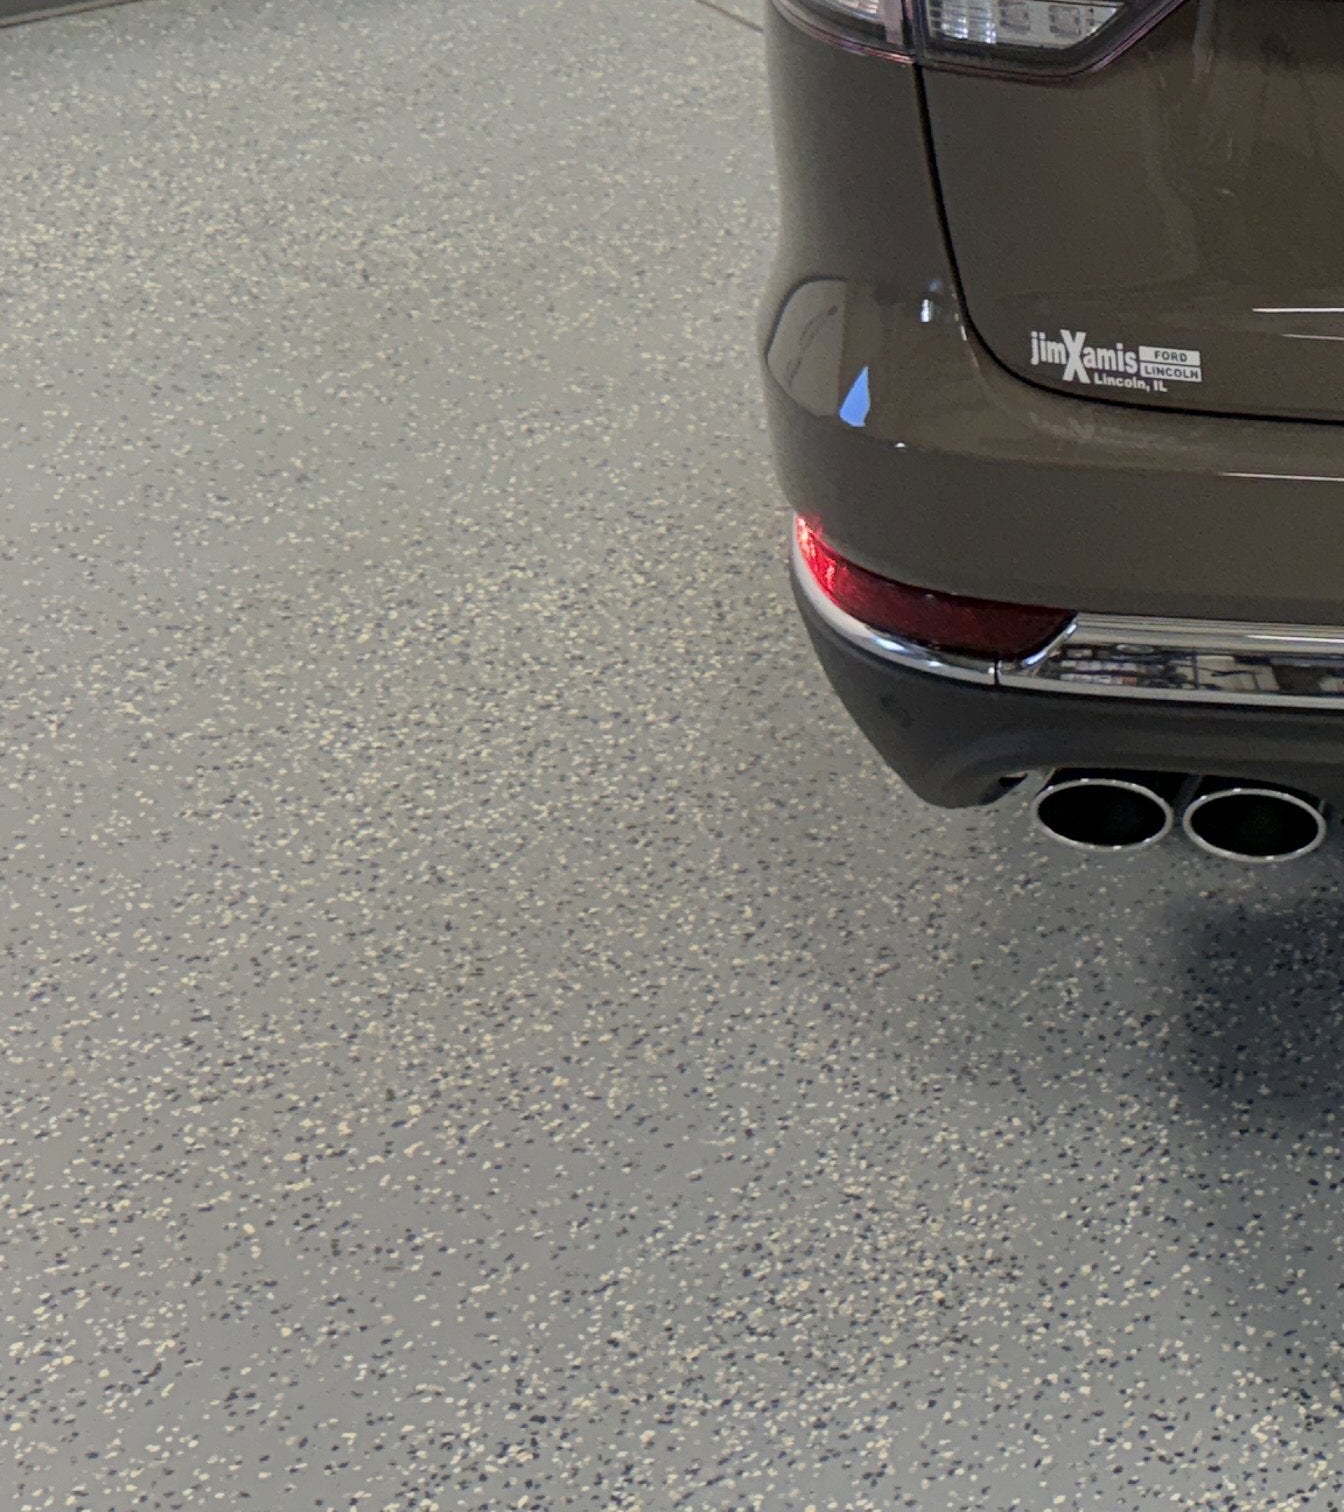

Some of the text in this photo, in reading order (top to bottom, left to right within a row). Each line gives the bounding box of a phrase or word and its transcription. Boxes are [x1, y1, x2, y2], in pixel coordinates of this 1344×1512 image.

[1154, 350, 1188, 362] FORD
[1144, 366, 1199, 379] LINCOLN
[1094, 373, 1168, 392] Lincoln, IL
